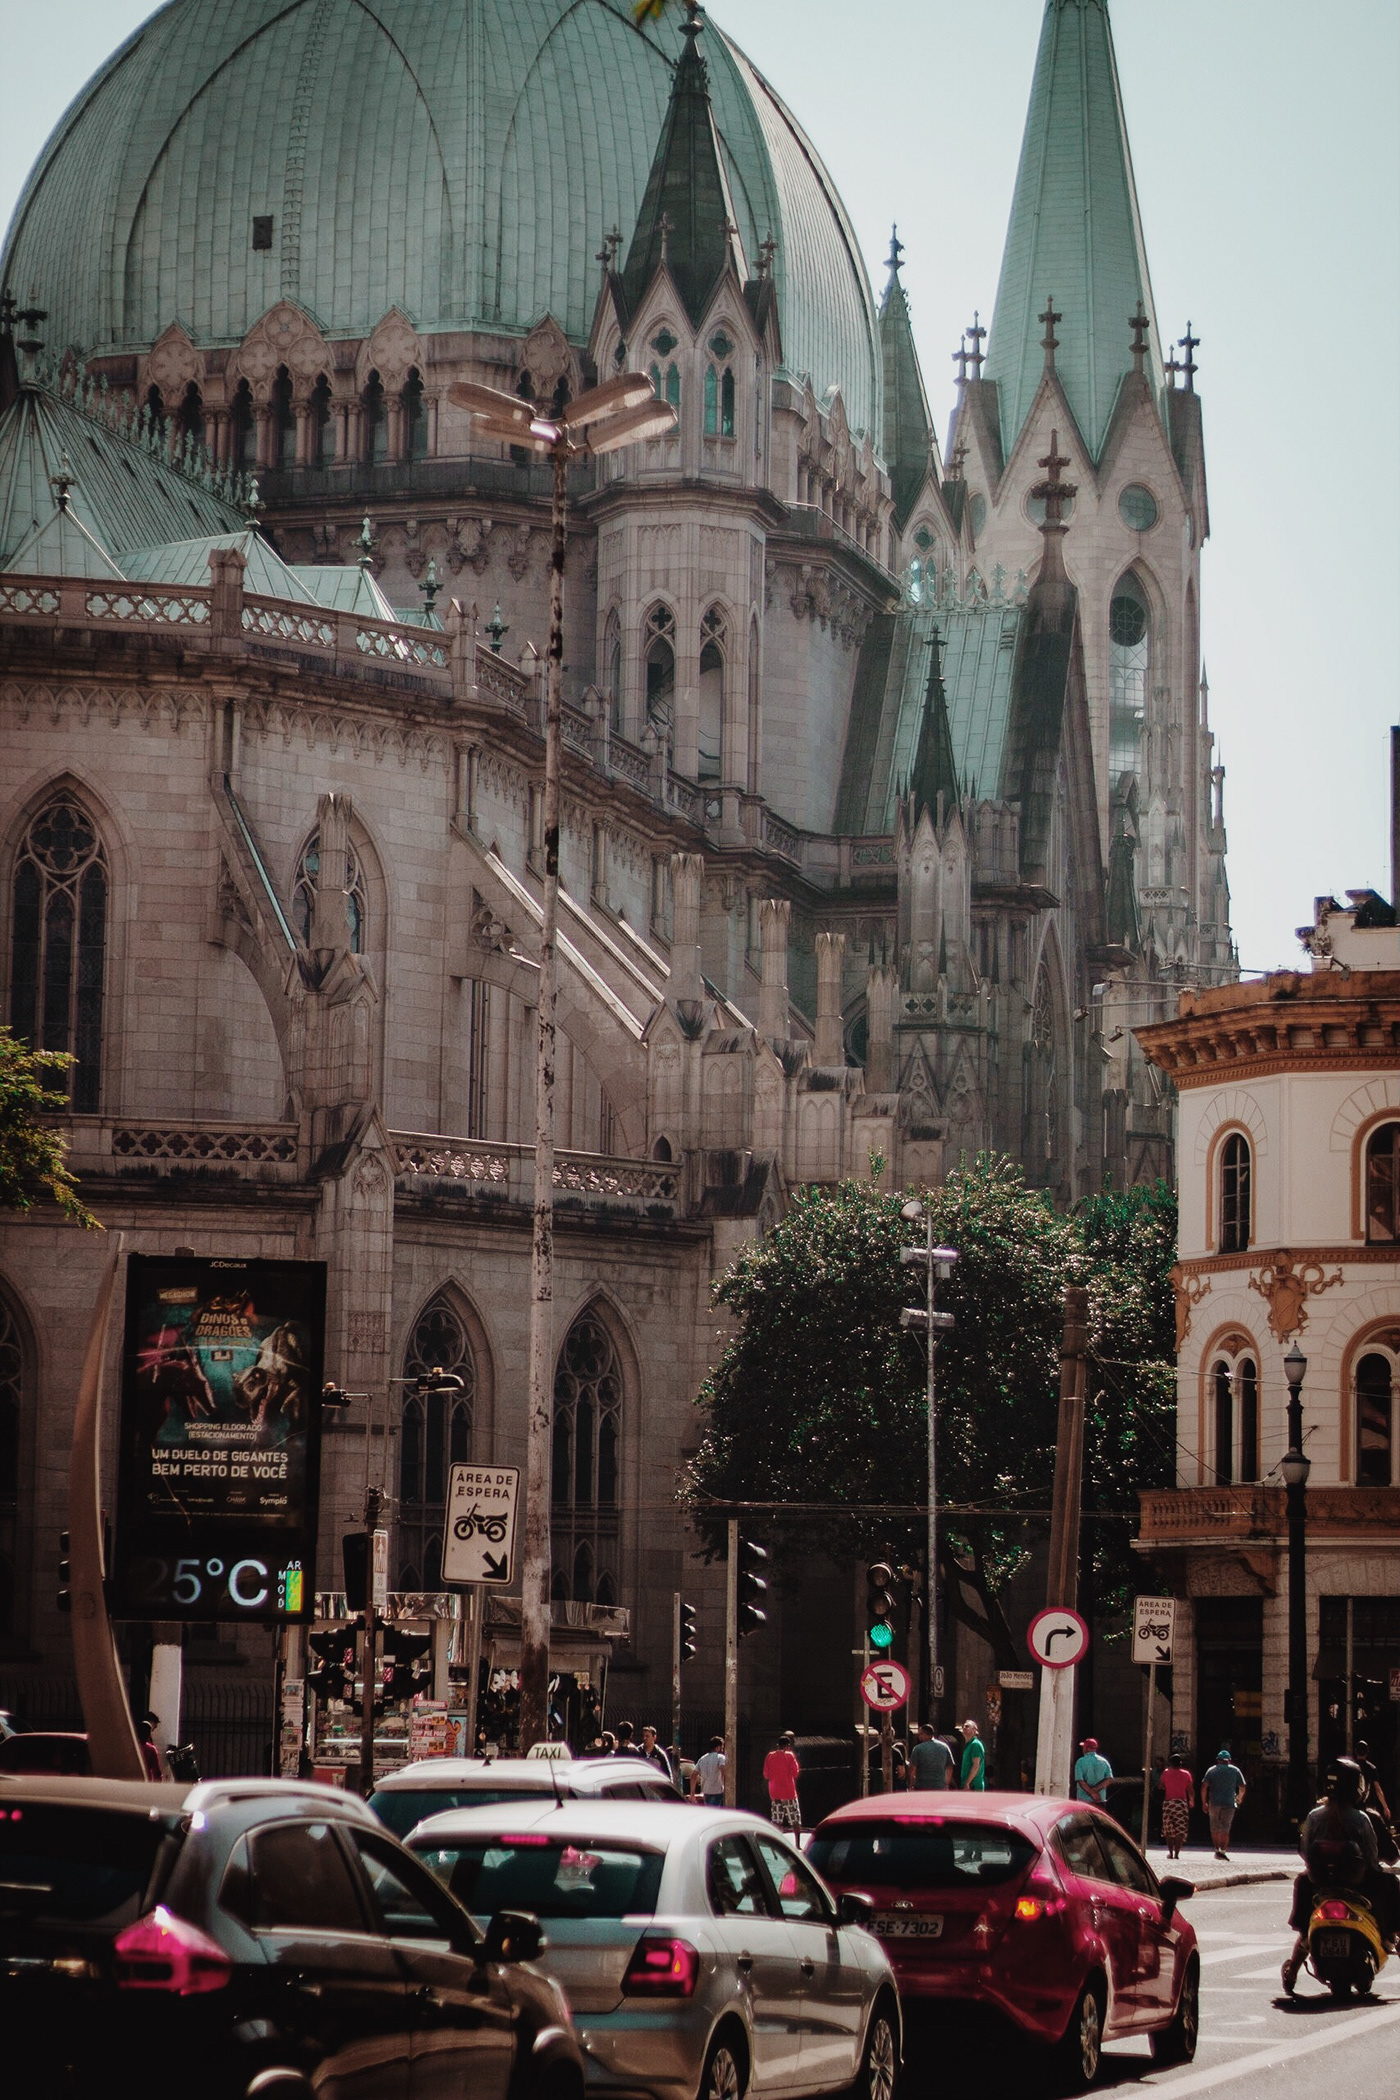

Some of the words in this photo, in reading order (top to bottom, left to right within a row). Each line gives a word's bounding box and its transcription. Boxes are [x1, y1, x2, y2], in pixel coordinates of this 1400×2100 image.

[184, 1422, 221, 1430] SHOPPING
[222, 1423, 263, 1431] ELDORADO
[188, 1431, 258, 1441] (ESTACIONAMENTO)
[152, 1449, 169, 1459] UM
[172, 1449, 210, 1461] DUELO
[213, 1451, 228, 1461] DE
[231, 1452, 288, 1463] GIGANTES
[152, 1463, 180, 1475] BEM
[183, 1464, 227, 1477] PERTO
[231, 1465, 249, 1478] DE
[252, 1463, 287, 1478] VOCÊ
[456, 1470, 492, 1484] ÁREA
[496, 1475, 513, 1485] DE
[456, 1486, 510, 1499] ESPERA
[286, 1561, 301, 1570] AR
[1139, 1609, 1171, 1617] ESPERA
[533, 1746, 562, 1759] TAXI
